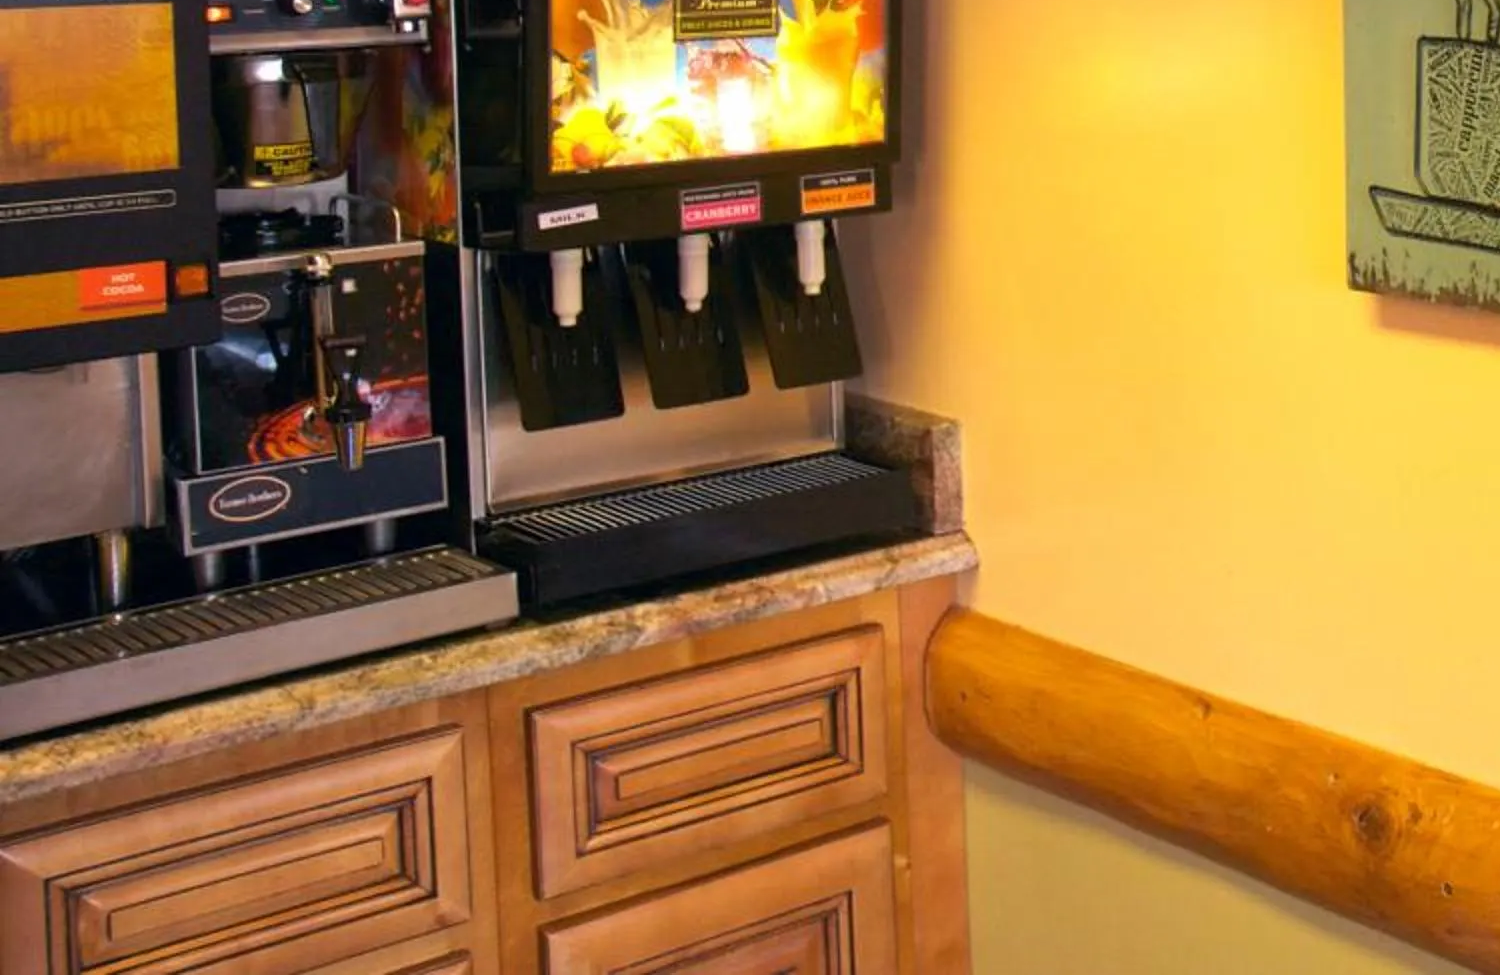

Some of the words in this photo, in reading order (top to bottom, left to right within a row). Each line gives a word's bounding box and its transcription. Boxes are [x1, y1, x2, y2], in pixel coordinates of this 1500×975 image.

[685, 203, 757, 223] CRANBERRY
[111, 272, 137, 283] HOT
[101, 284, 145, 296] COCOA
